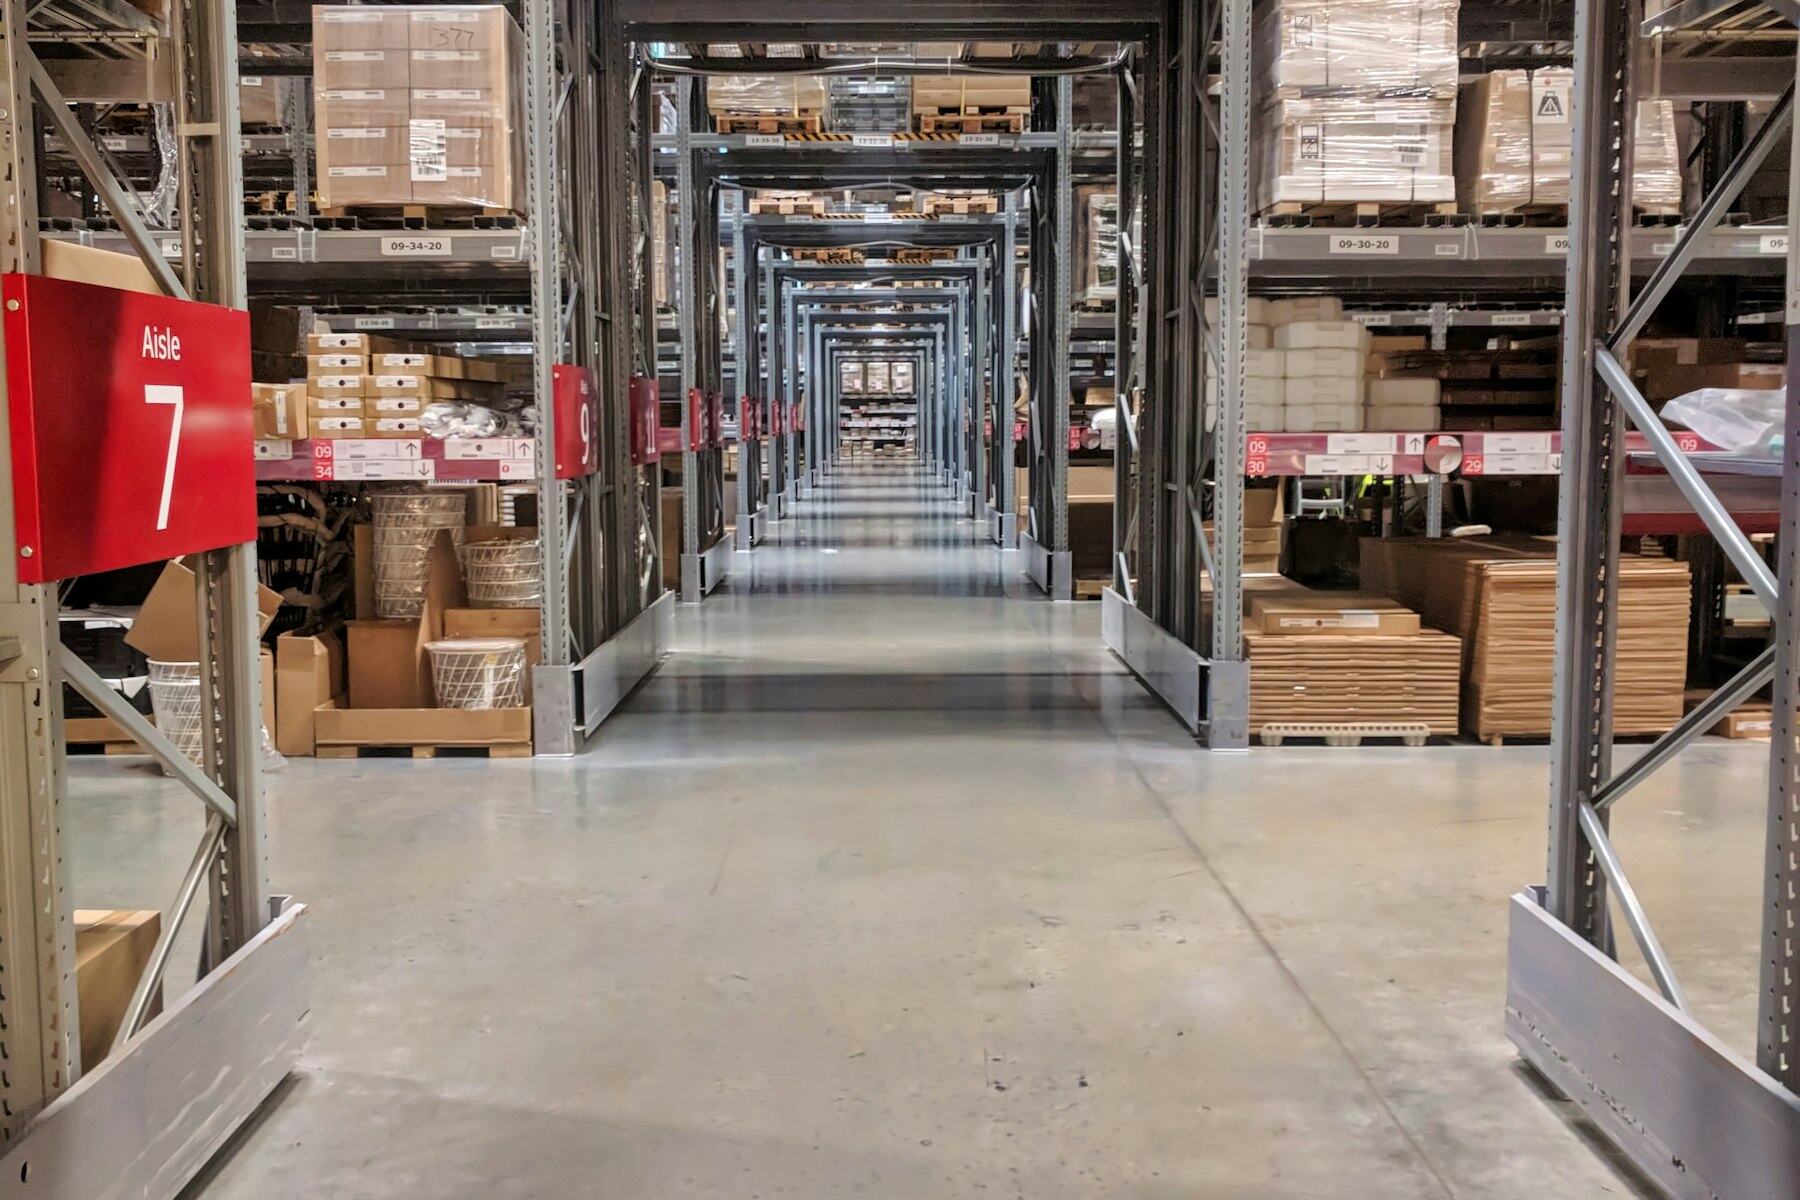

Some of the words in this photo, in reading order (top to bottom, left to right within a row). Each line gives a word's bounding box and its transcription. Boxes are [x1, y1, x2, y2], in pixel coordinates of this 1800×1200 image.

[432, 27, 475, 47] 377
[391, 241, 442, 251] 09-34-20
[1339, 240, 1389, 249] 09-30-20
[141, 325, 182, 361] Aisle
[580, 403, 590, 465] 9
[1249, 441, 1266, 453] 09
[1680, 439, 1697, 451] 09
[144, 384, 184, 531] 7
[315, 446, 332, 458] 09
[315, 465, 332, 479] 34
[1248, 461, 1265, 473] 30
[1465, 460, 1482, 472] 29
